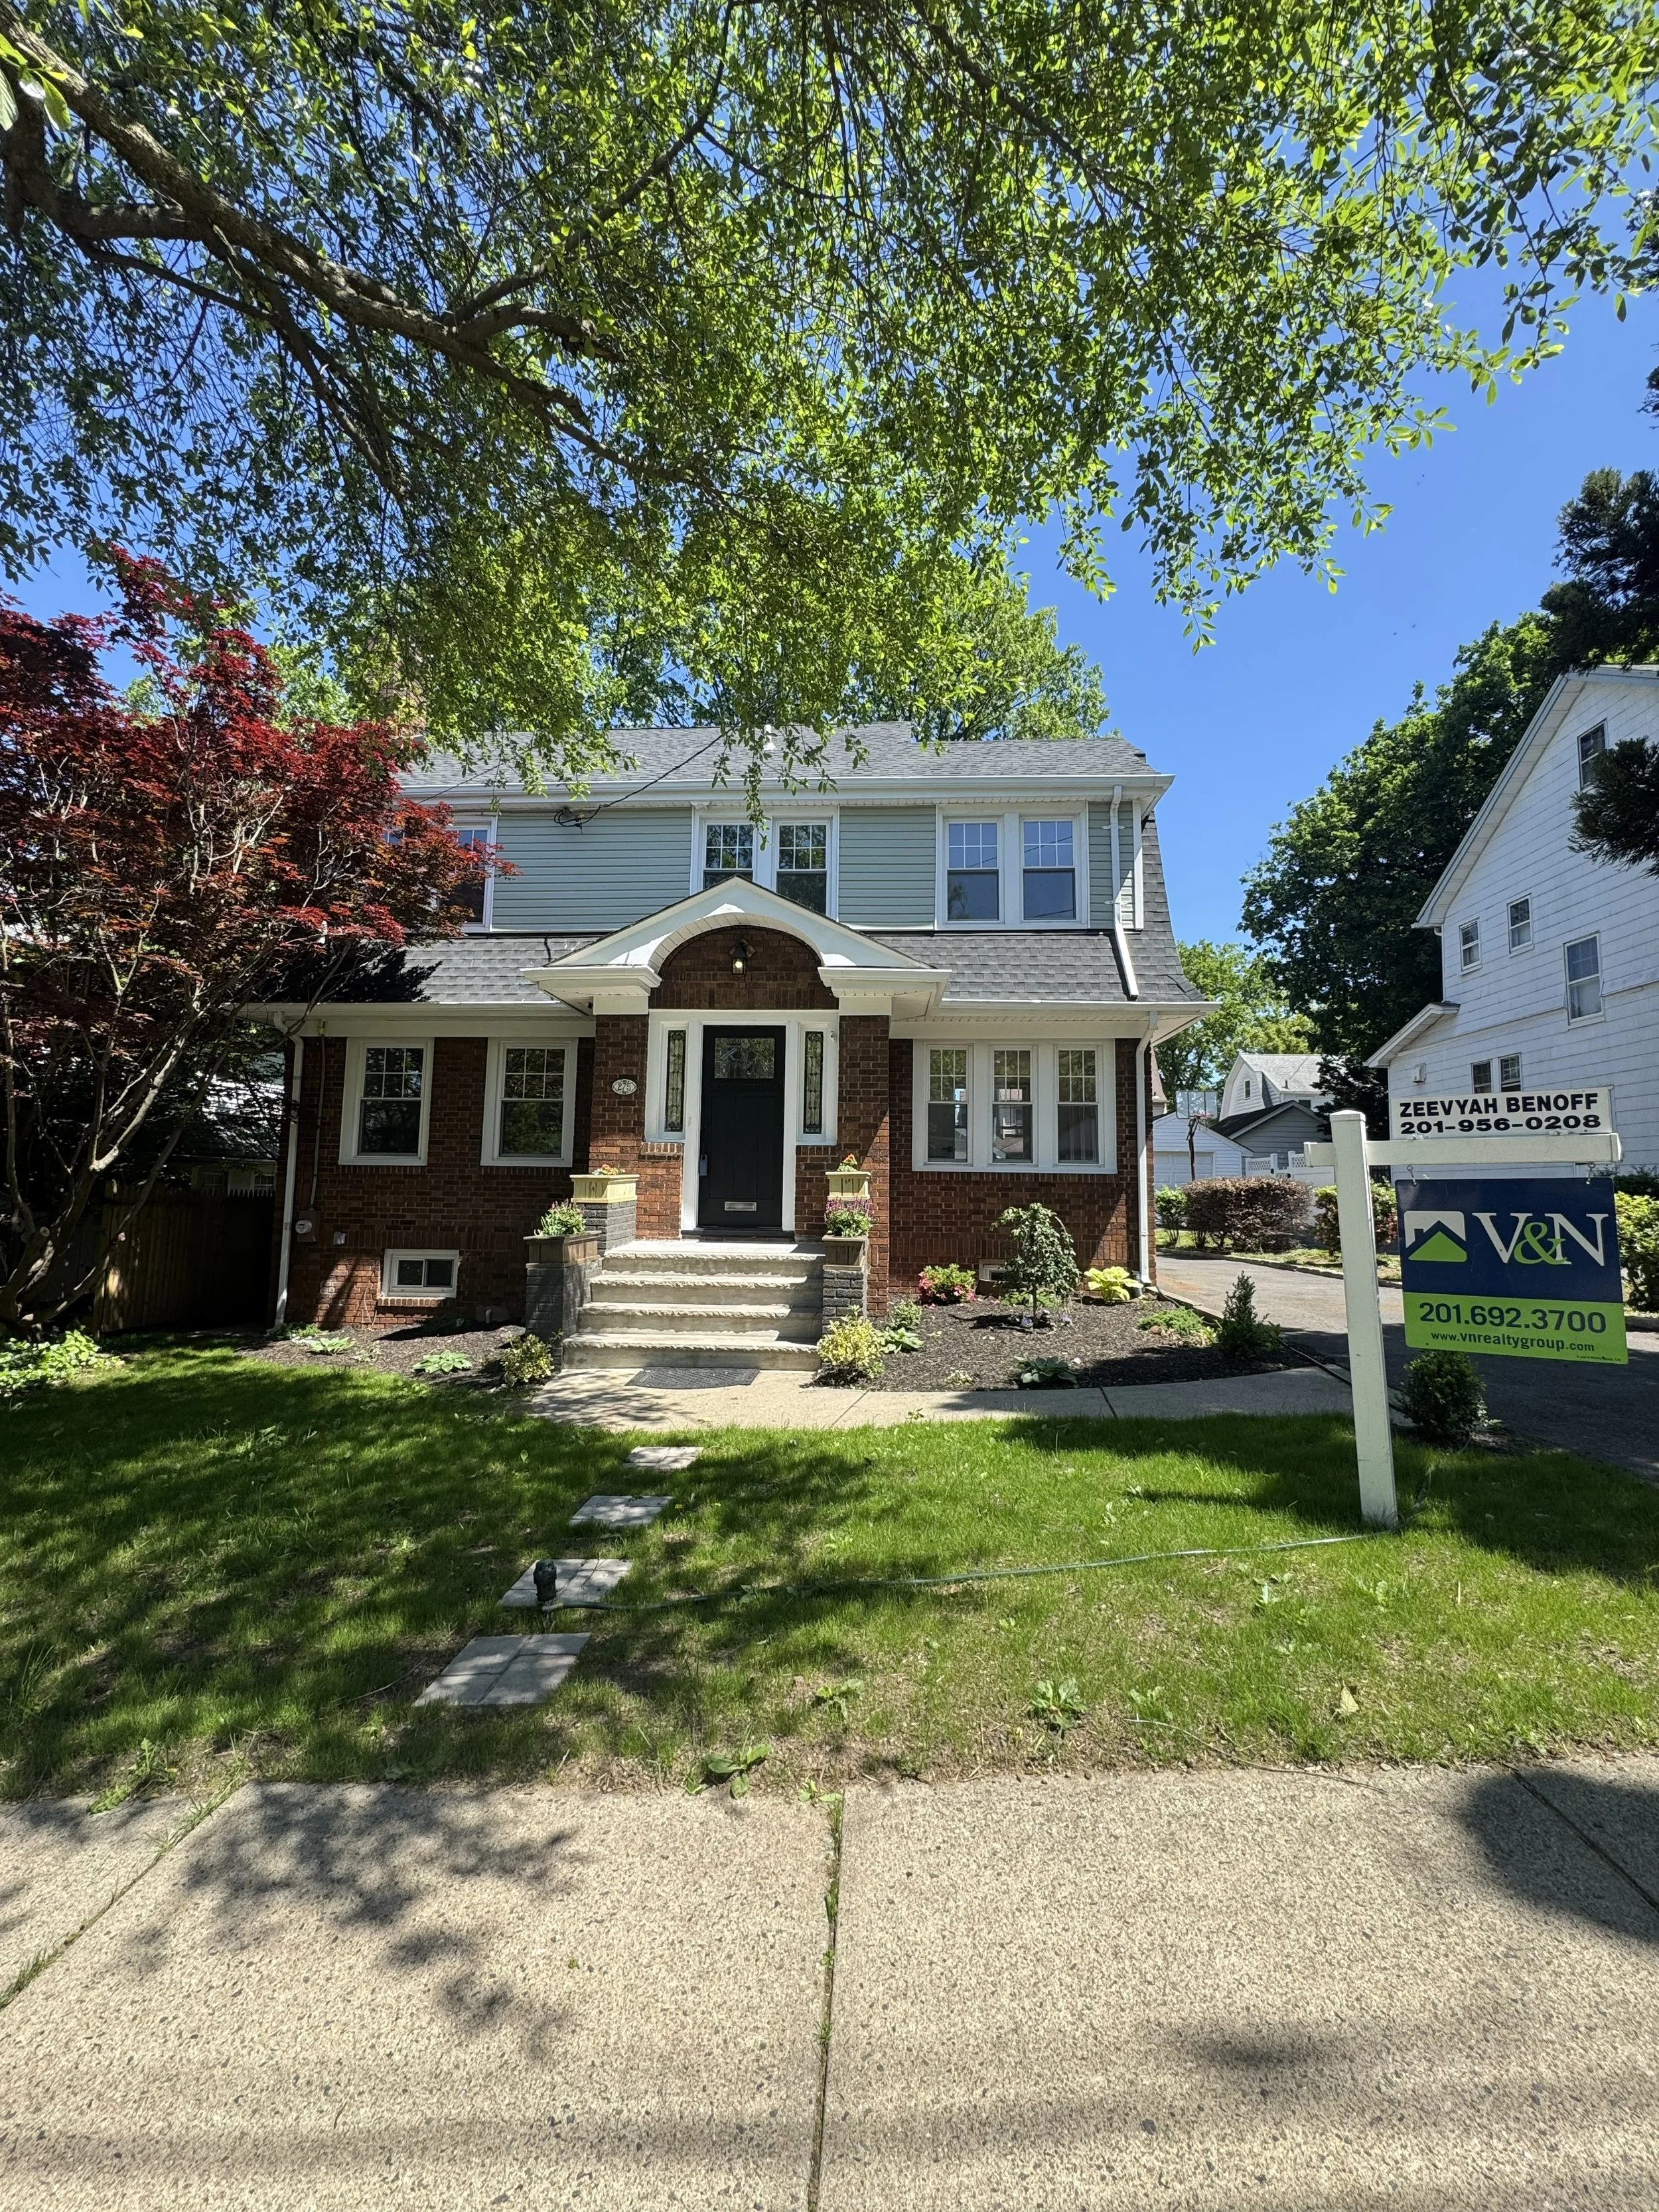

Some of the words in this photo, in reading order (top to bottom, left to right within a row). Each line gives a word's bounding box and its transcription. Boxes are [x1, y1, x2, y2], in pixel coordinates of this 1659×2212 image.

[618, 1082, 631, 1091] 275
[1400, 1098, 1498, 1118] ZEEVYAH
[1506, 1093, 1598, 1113] BENOFF
[1400, 1114, 1601, 1134] 201-956-0208
[1472, 1213, 1609, 1266] V&N
[1419, 1301, 1606, 1333] 201.692.3700
[1431, 1332, 1595, 1352] www.vnrealtygroup.com
